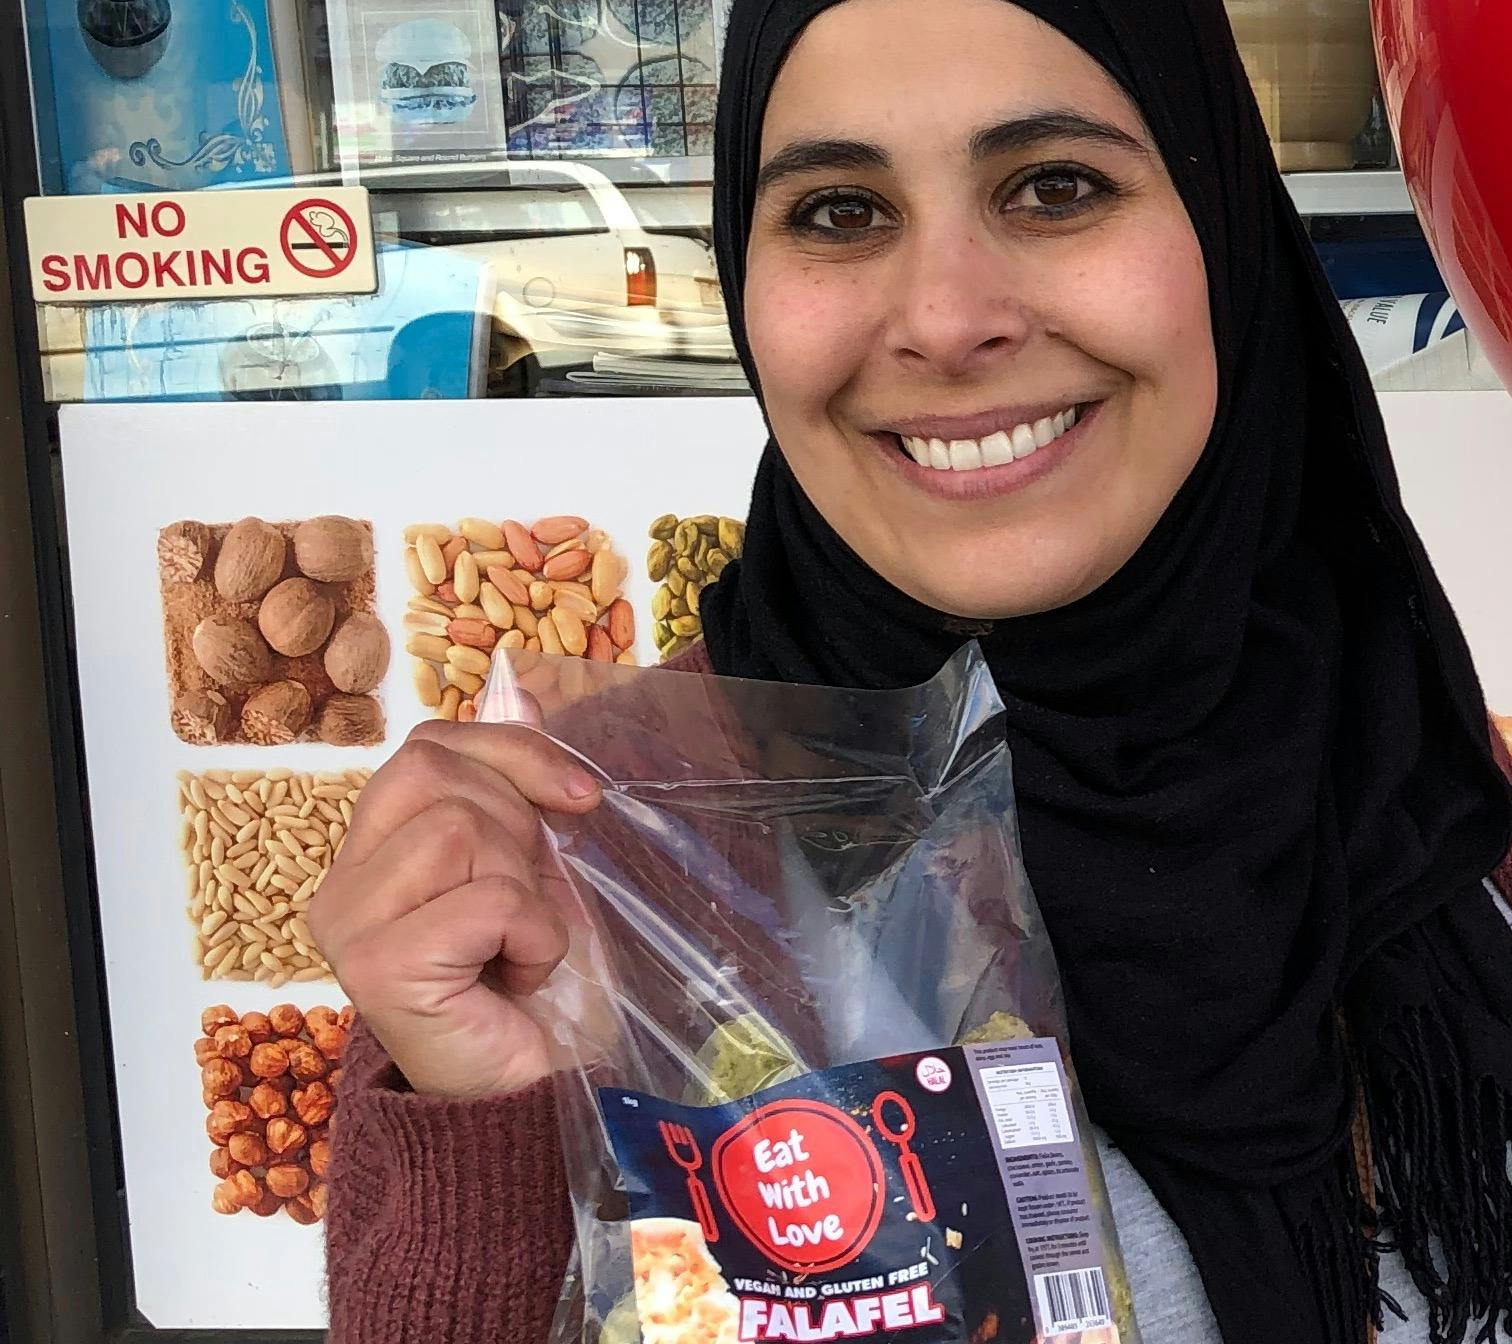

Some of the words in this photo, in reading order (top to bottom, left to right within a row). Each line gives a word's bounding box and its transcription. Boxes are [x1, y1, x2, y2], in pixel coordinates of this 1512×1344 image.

[116, 201, 185, 238] NO
[41, 246, 270, 293] SMOKING
[754, 1129, 810, 1173] Eat
[768, 1214, 844, 1247] Love
[734, 1277, 781, 1296] VEGAN
[784, 1286, 817, 1299] AND
[821, 1275, 884, 1296] GLUTEN
[888, 1262, 929, 1285] FREE
[740, 1284, 943, 1341] FALAFEL
